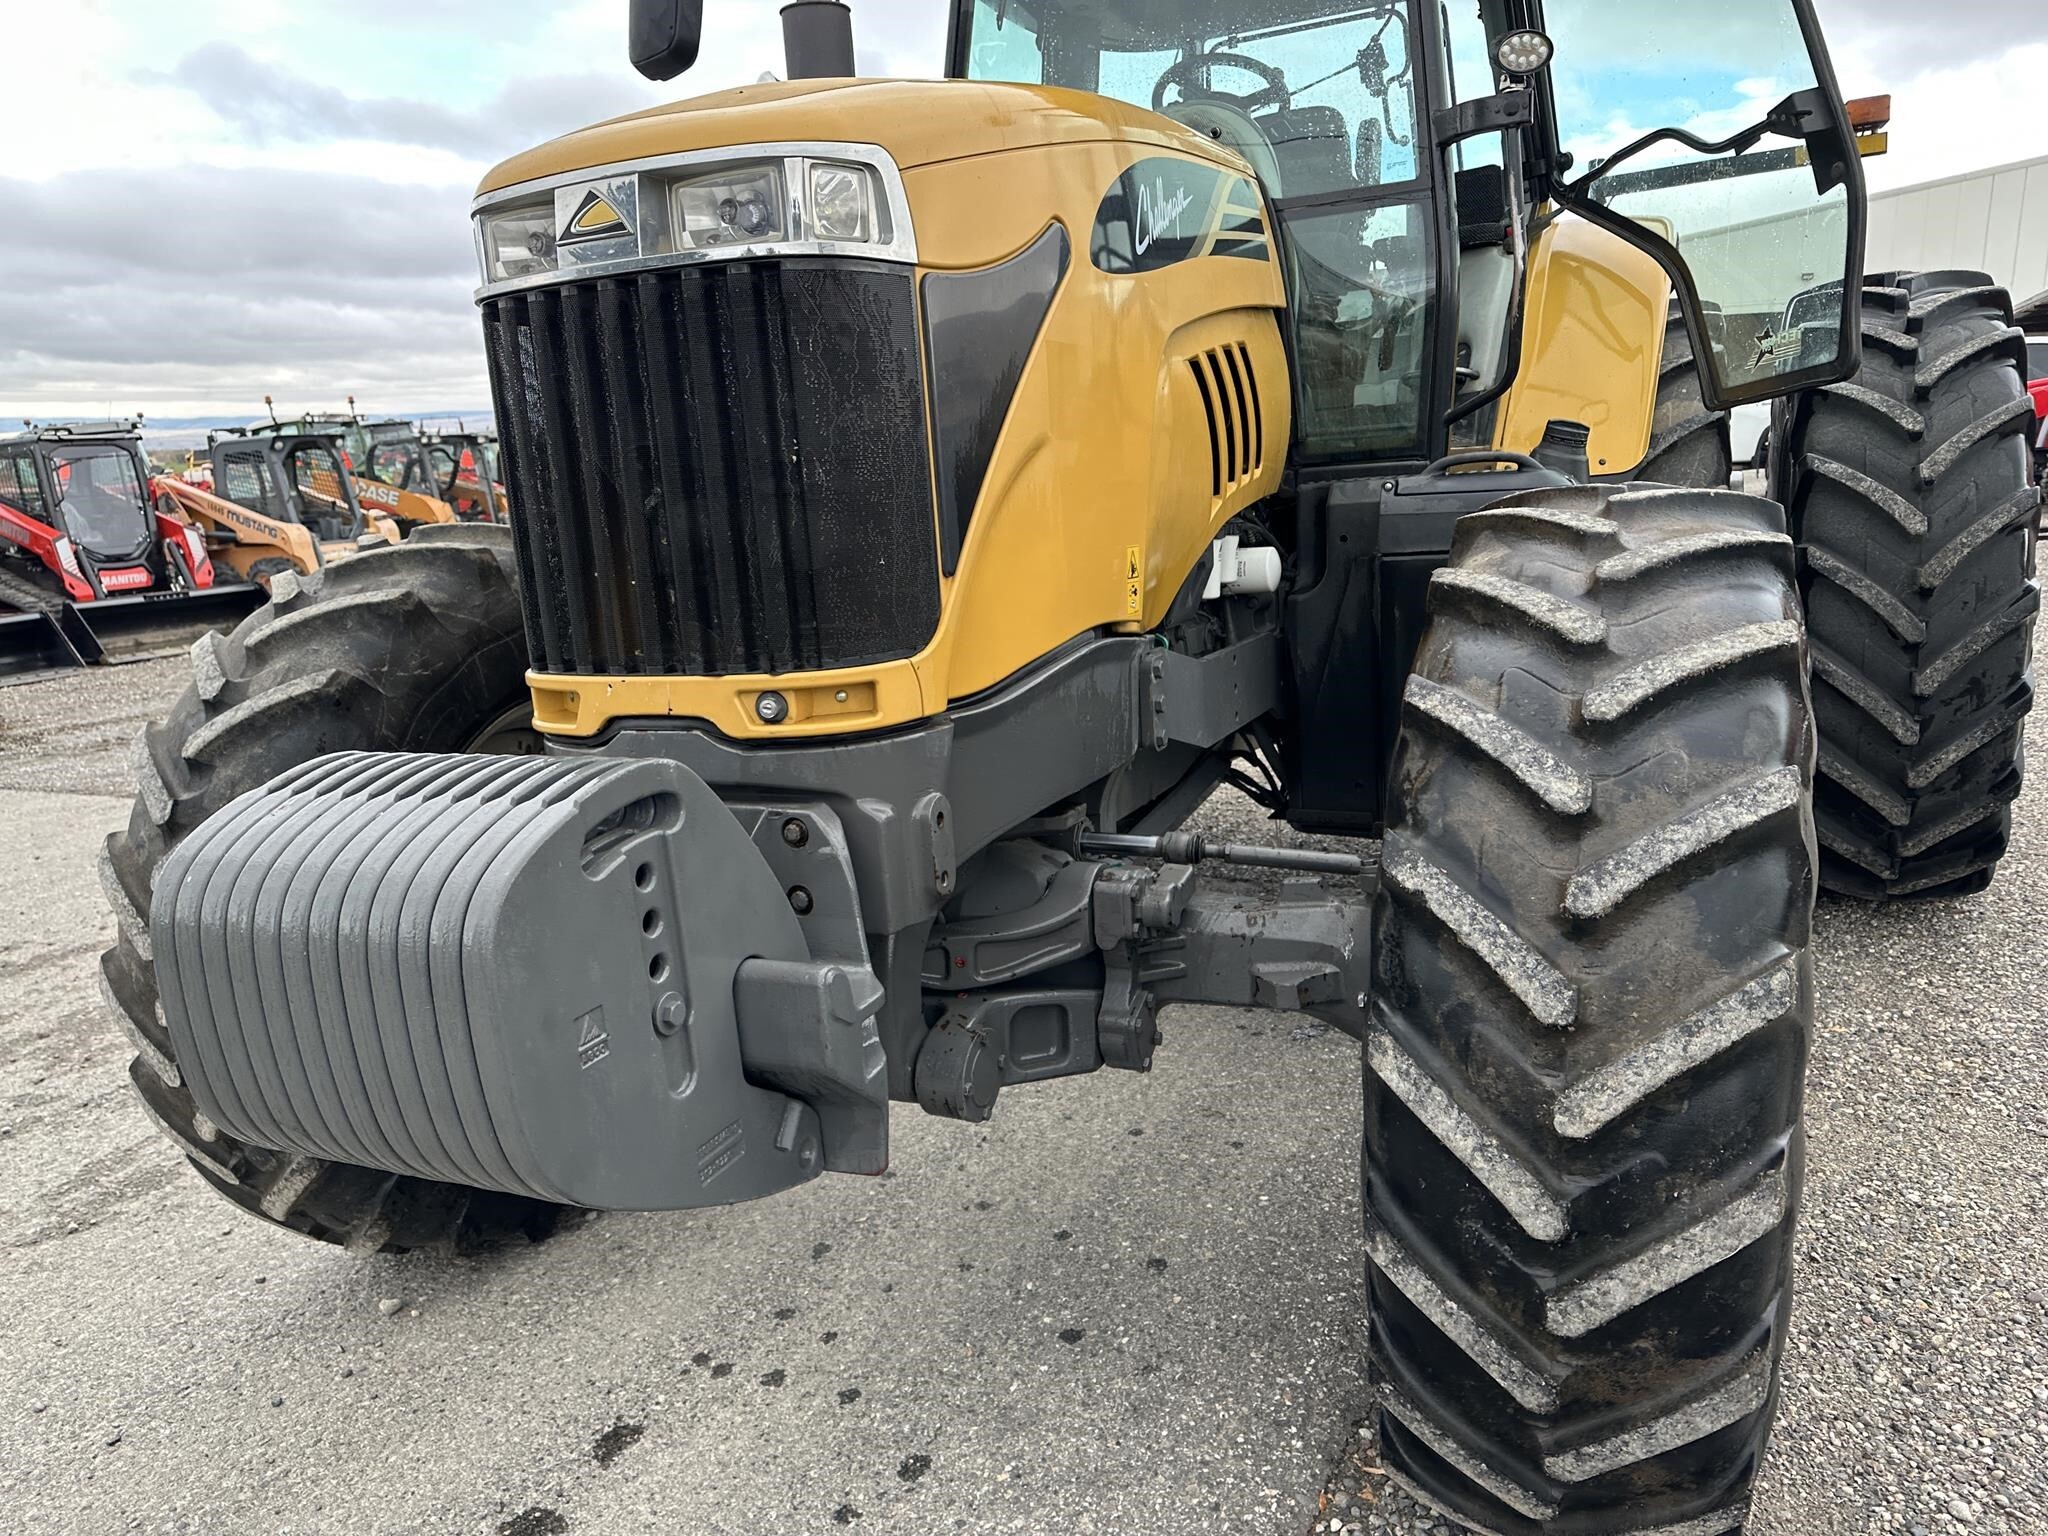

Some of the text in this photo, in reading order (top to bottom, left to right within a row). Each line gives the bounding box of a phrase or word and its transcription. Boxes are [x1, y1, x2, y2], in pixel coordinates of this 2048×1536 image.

[1136, 176, 1193, 255] Challenger
[355, 481, 399, 506] CASE
[227, 510, 277, 538] MUSTANG
[101, 573, 147, 586] MANITOU
